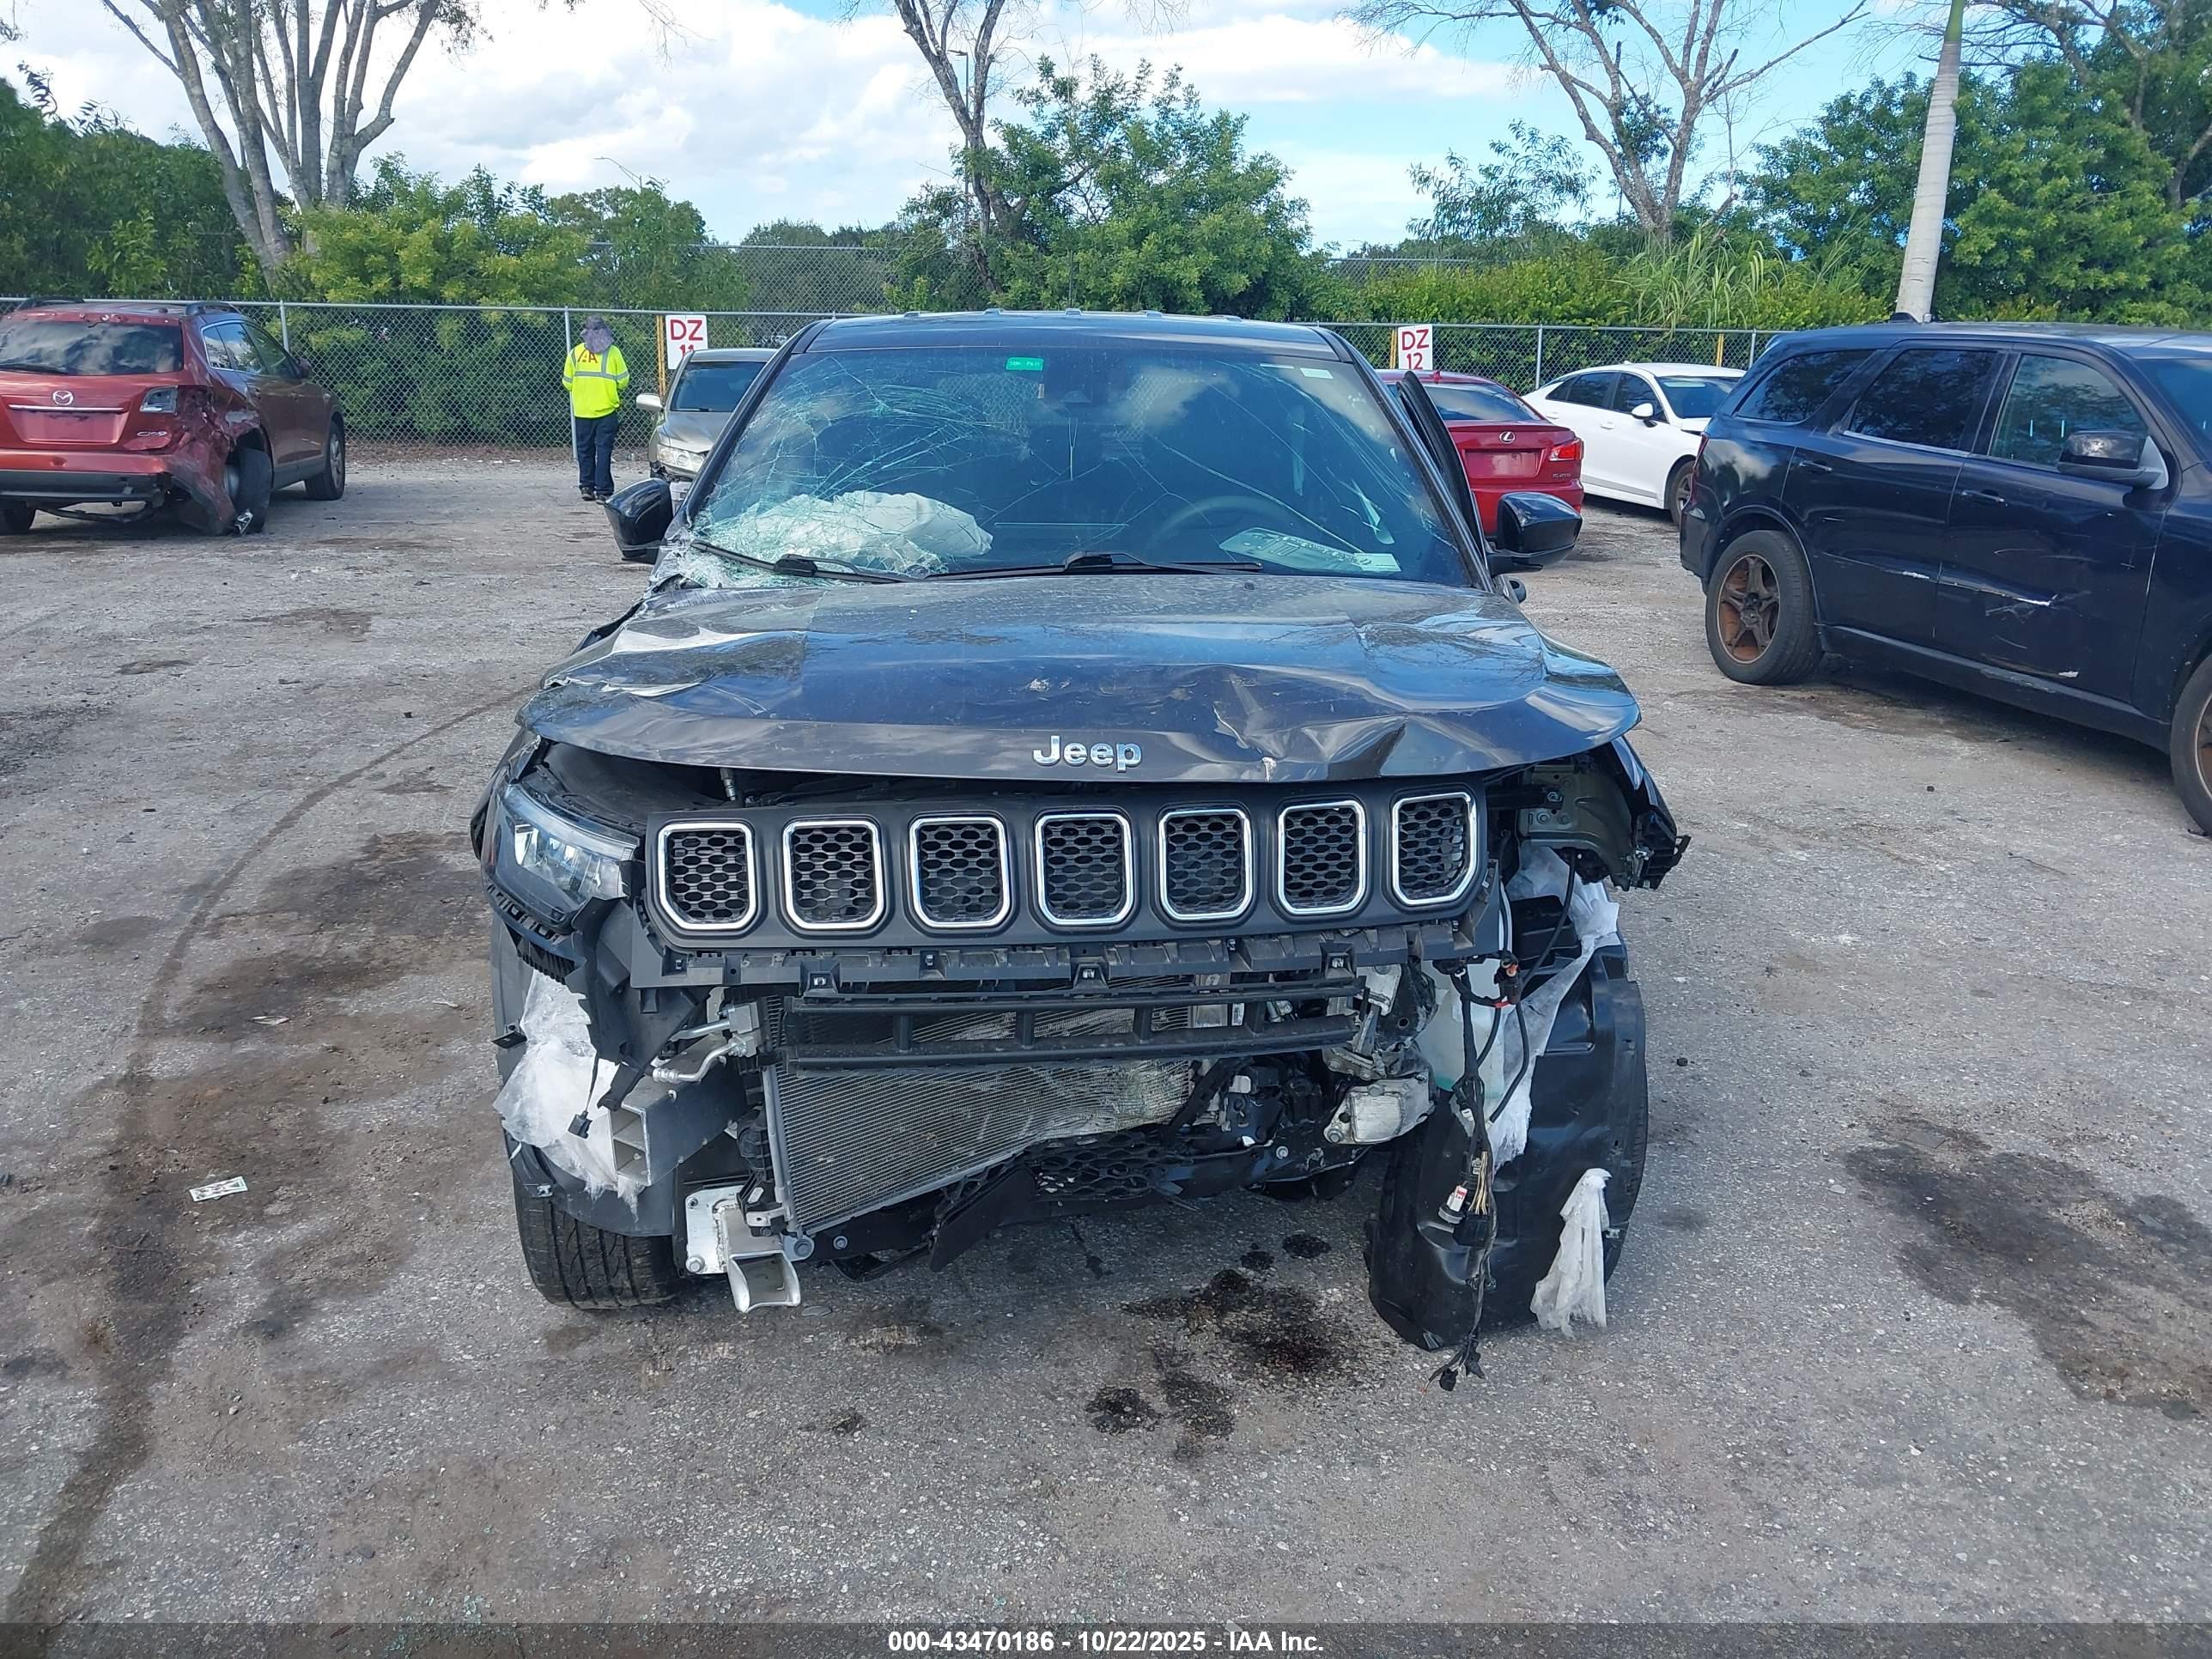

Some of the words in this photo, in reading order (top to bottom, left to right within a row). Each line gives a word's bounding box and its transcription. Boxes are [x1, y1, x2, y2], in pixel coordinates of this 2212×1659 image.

[671, 319, 703, 341] DZ
[1401, 329, 1429, 350] DZ
[1407, 353, 1423, 369] 12
[1033, 735, 1142, 773] Jeep
